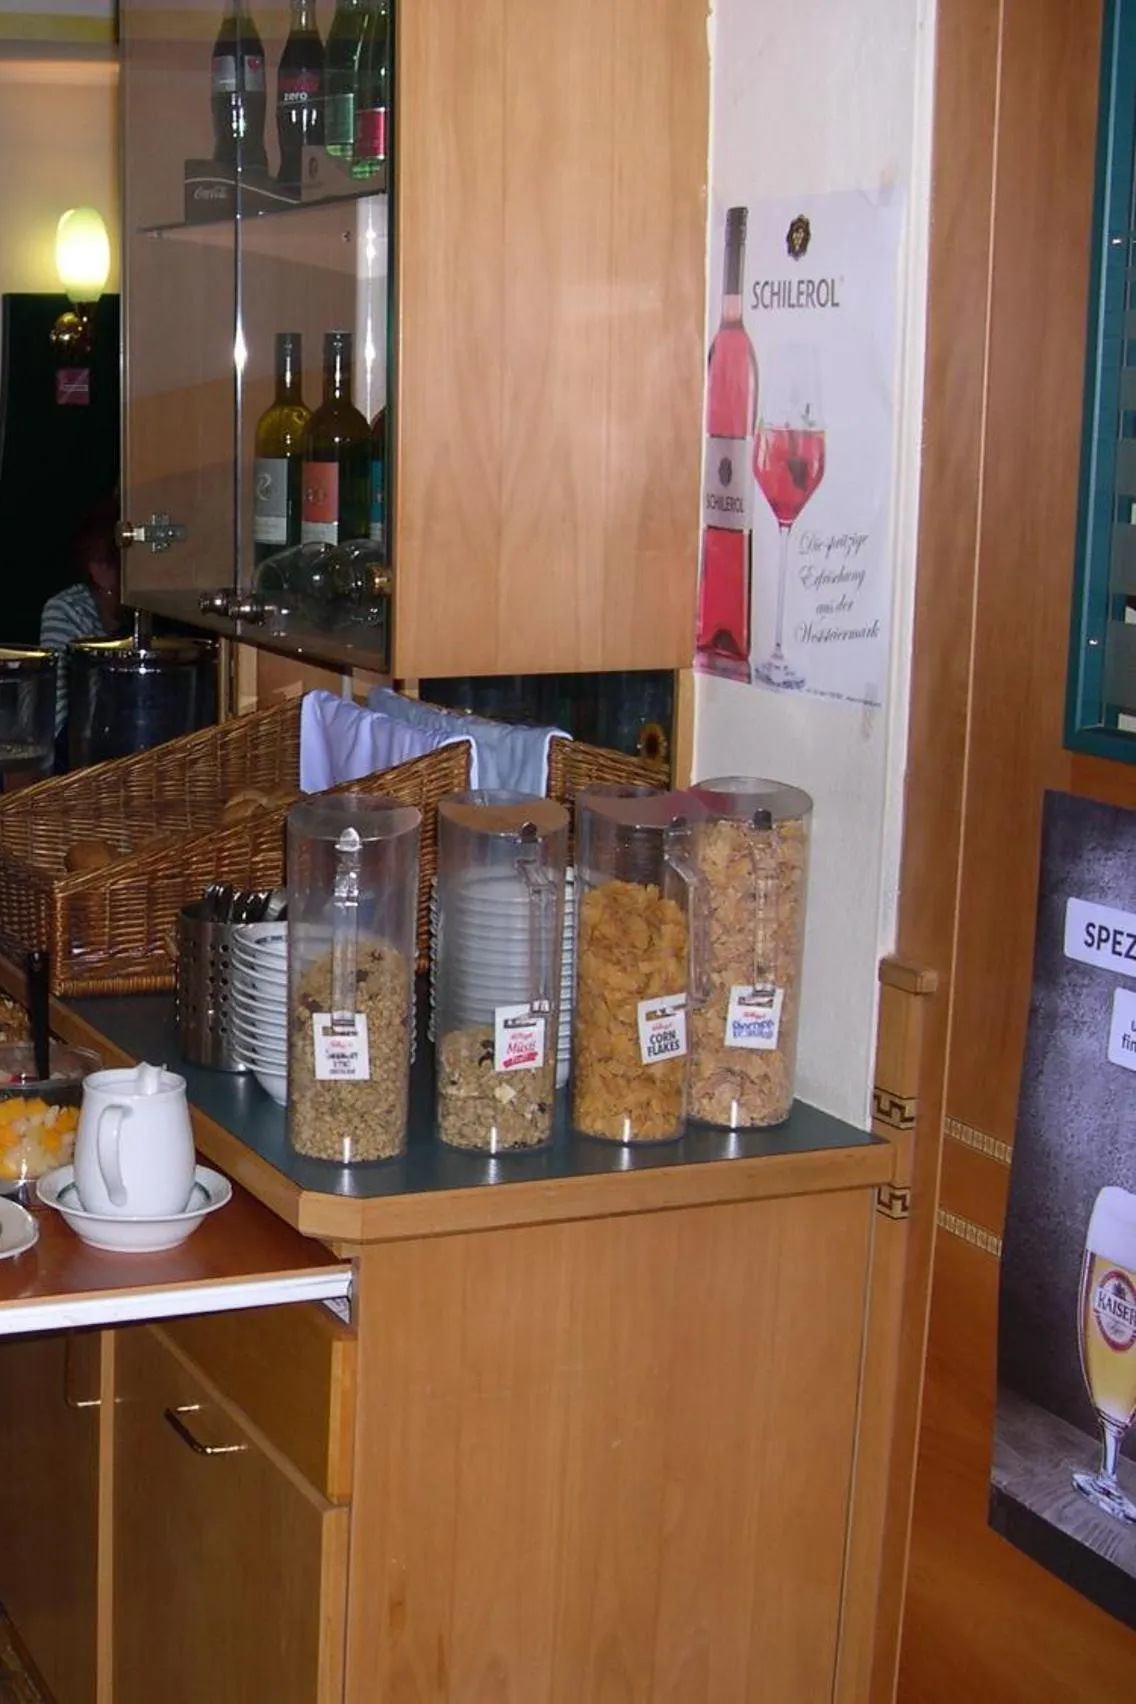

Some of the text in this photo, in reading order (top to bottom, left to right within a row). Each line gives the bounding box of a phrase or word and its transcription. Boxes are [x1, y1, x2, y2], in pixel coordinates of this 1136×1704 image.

[284, 91, 308, 102] zero
[751, 277, 840, 310] SCHILEROL
[649, 1029, 676, 1045] CORN
[647, 1039, 681, 1057] FLAKES
